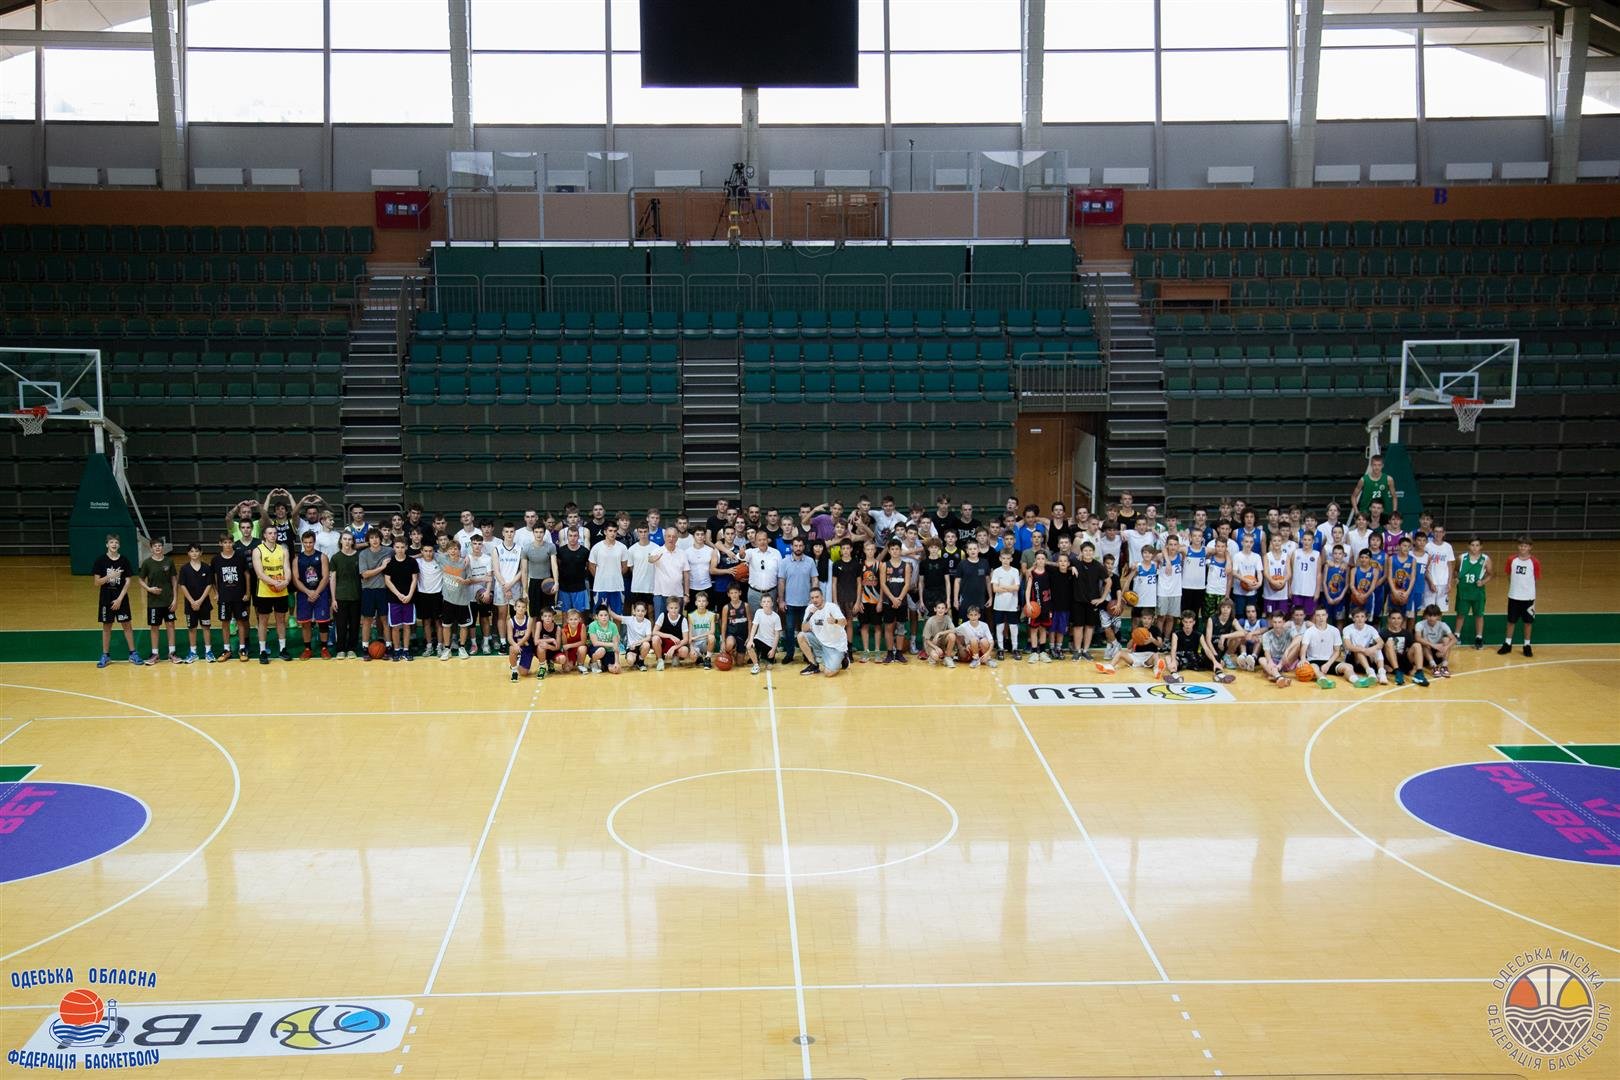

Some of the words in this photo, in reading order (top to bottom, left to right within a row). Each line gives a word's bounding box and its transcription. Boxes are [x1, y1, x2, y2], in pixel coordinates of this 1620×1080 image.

[277, 532, 288, 541] 23
[221, 566, 237, 574] BREAK
[1300, 562, 1309, 572] 13
[1465, 573, 1476, 583] 13
[1028, 686, 1142, 700] FBU
